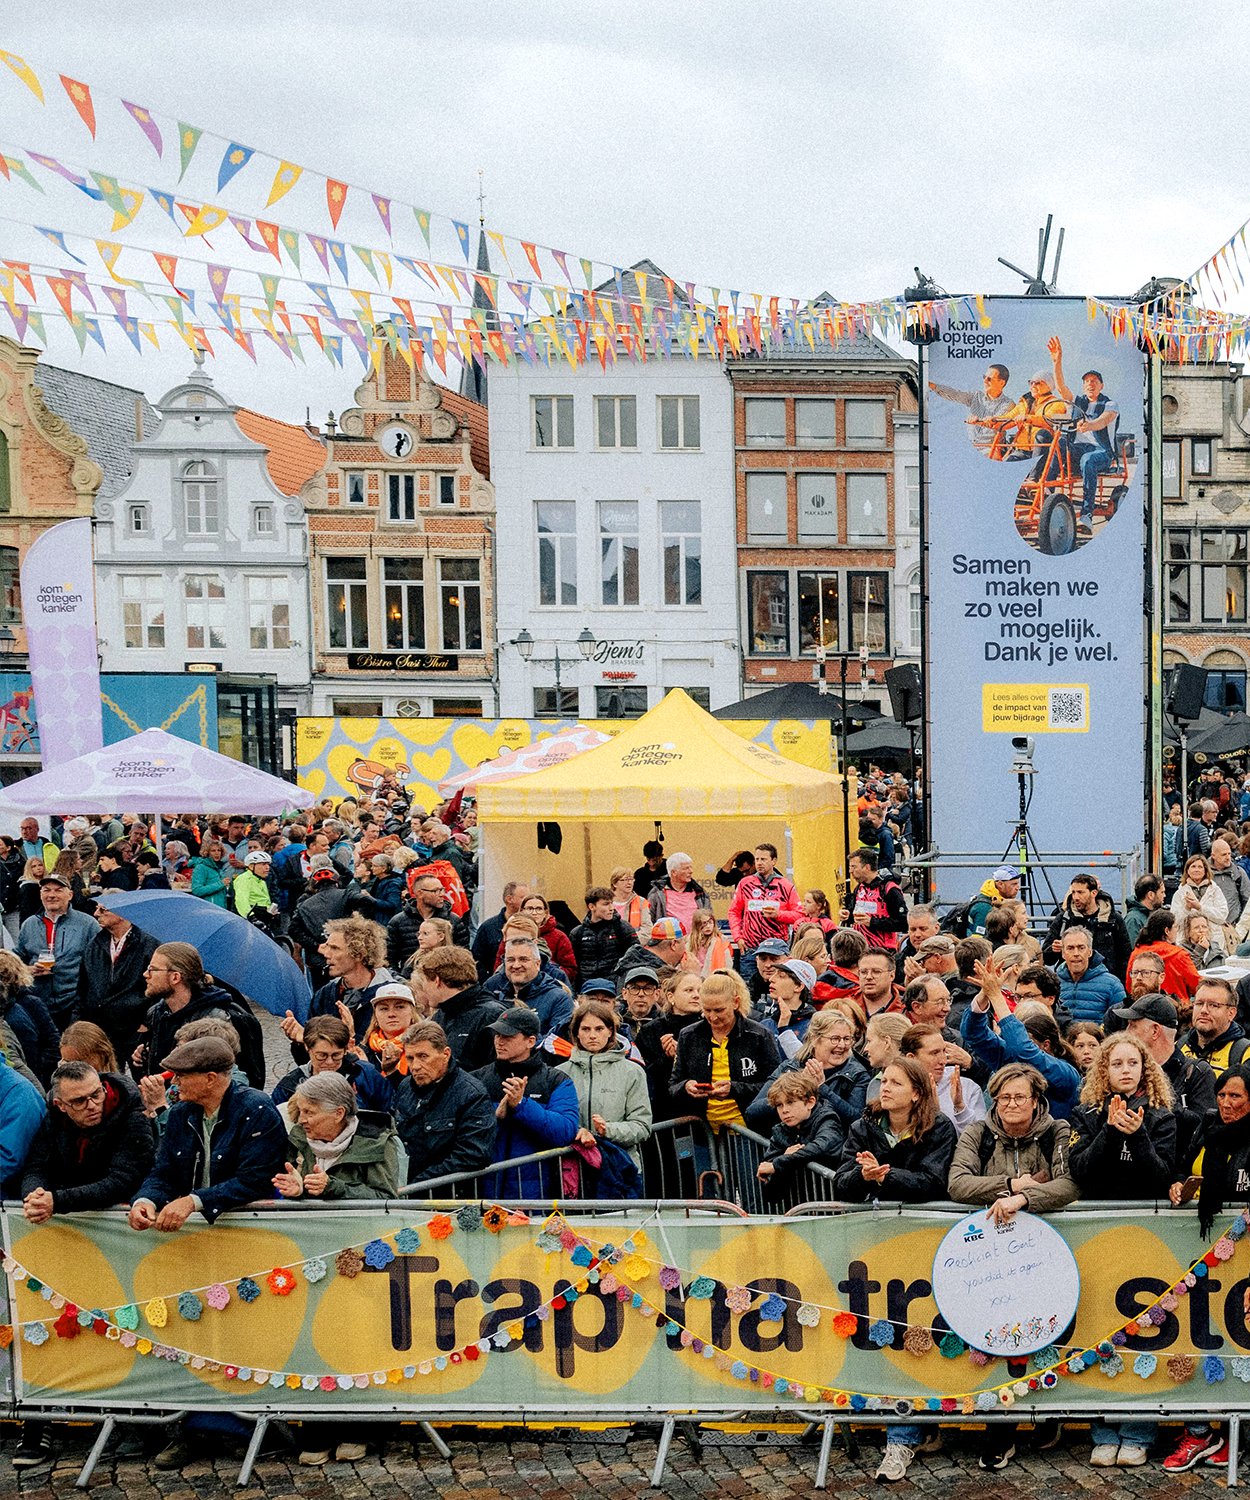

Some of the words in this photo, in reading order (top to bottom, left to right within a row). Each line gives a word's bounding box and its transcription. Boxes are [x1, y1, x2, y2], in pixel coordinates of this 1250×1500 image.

[948, 318, 978, 331] kom
[943, 333, 961, 346] op
[962, 332, 1003, 348] tegen
[948, 346, 995, 358] kanker
[952, 554, 1031, 575] Samen
[40, 585, 63, 594] kom
[986, 577, 1060, 597] maken
[1067, 581, 1099, 597] we
[36, 594, 51, 604] op
[51, 594, 83, 605] tegen
[41, 604, 77, 613] kanker
[964, 602, 992, 618] zo
[998, 598, 1042, 618] veel
[1001, 618, 1101, 643] mogelijk.
[985, 641, 1042, 662] Dank
[1047, 642, 1068, 667] je
[1074, 641, 1118, 662] wel.
[356, 653, 393, 668] Bistro
[422, 655, 450, 668] Thai
[992, 693, 1010, 701] Lees
[1011, 693, 1029, 701] alles
[1004, 704, 1031, 713] impact
[992, 714, 1011, 722] jouw
[1013, 714, 1046, 722] bijdrage
[630, 744, 661, 754] kom
[640, 750, 683, 760] tegen
[621, 757, 672, 768] kanker
[963, 1233, 985, 1243] KBC
[365, 1255, 625, 1379] Trap
[664, 1277, 804, 1352] na
